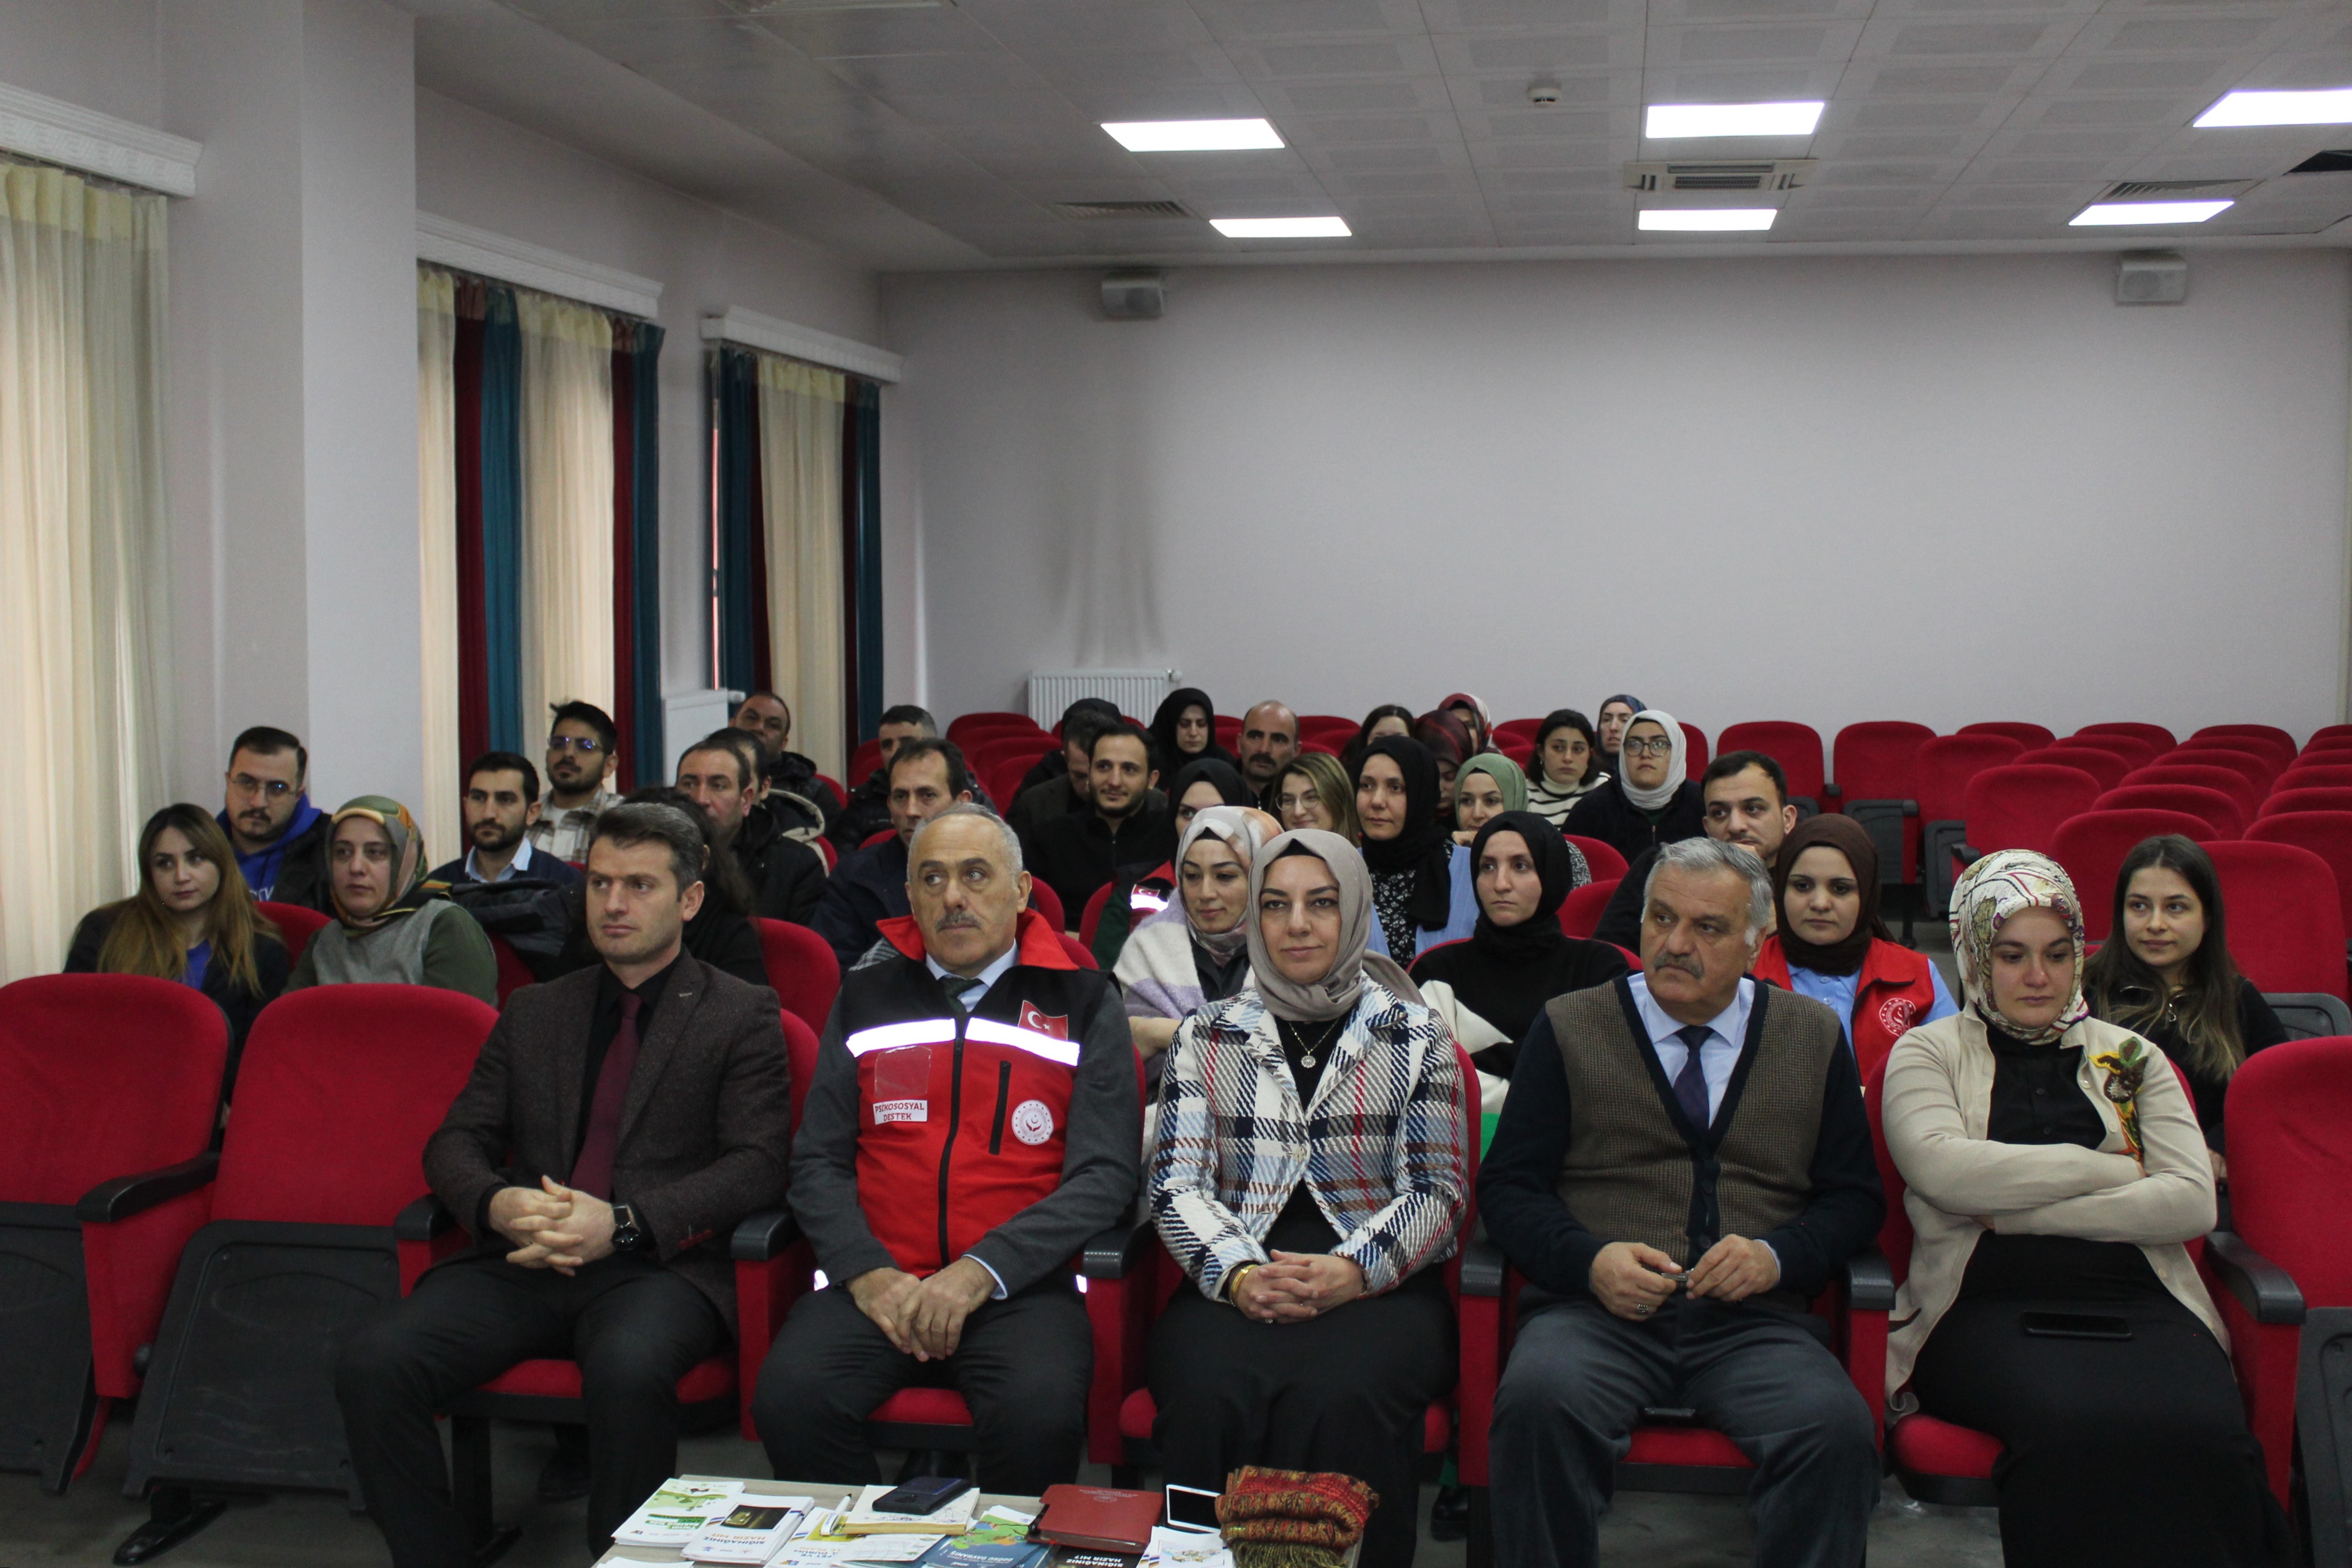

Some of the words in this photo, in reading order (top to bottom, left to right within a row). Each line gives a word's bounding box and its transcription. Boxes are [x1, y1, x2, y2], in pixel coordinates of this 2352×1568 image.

[875, 1102, 924, 1113] PSİKOSOSYAL
[883, 1113, 912, 1122] DESTEK
[703, 1536, 766, 1545] SIĞINAĞINIZ
[949, 1550, 987, 1561] DAVRANIŞ
[1066, 1559, 1124, 1568] SIĞINAĞINIZ
